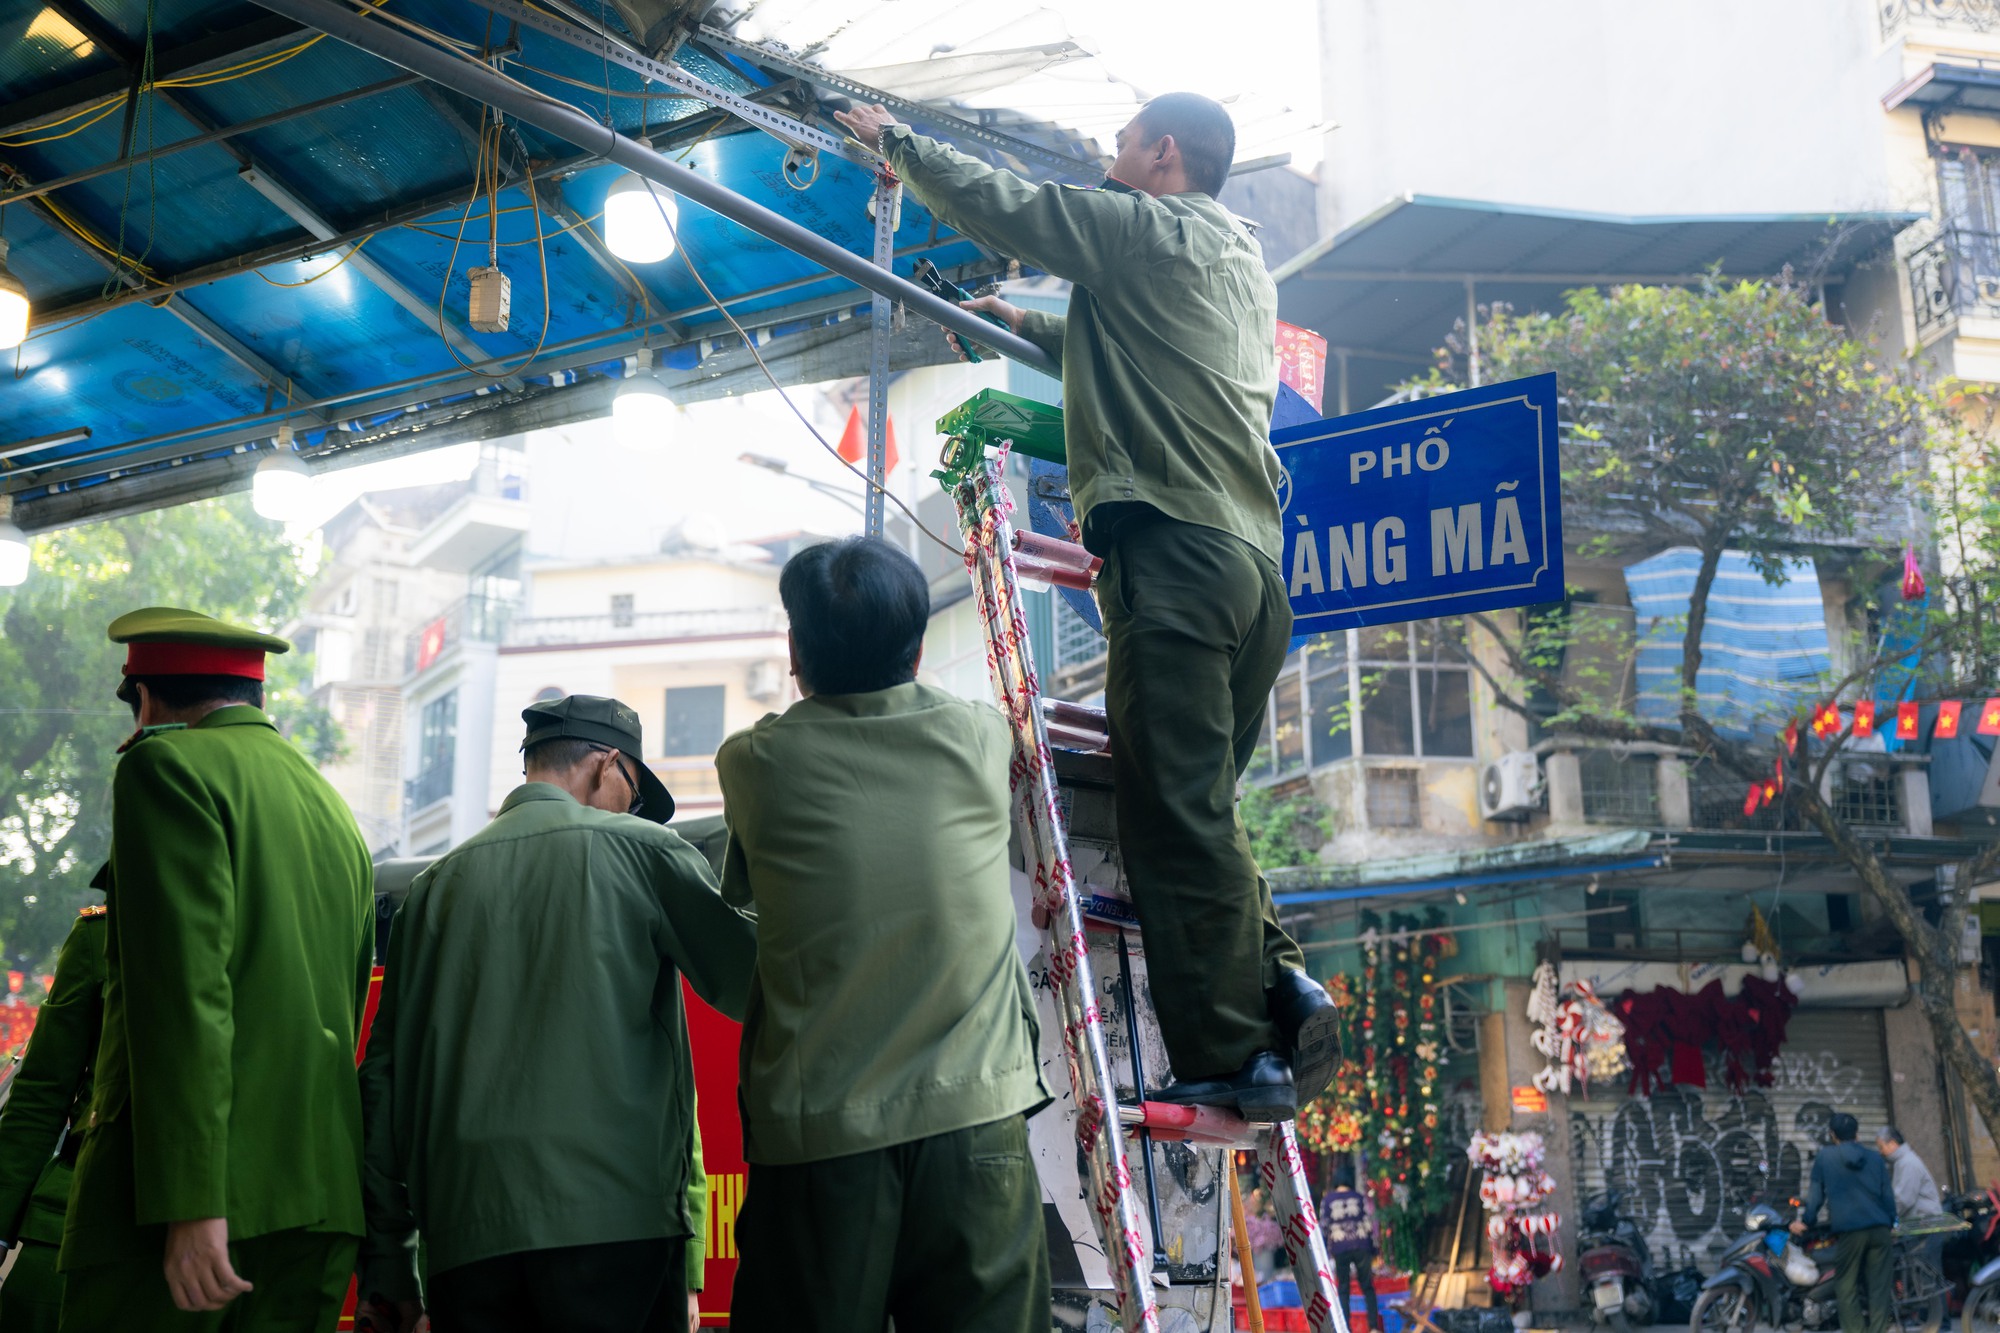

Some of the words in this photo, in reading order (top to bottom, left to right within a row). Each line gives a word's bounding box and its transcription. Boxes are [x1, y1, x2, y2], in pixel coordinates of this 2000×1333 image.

[751, 168, 790, 199] SHEET
[787, 200, 808, 215] PC
[825, 219, 856, 246] YEAR
[121, 336, 167, 364] SHEET
[141, 336, 208, 380] WARRANTY
[167, 362, 189, 377] PC
[212, 379, 242, 402] YEAR
[1349, 417, 1455, 485] PHỐ
[1286, 514, 1407, 598] ÀNG
[1430, 479, 1532, 577] MÃ
